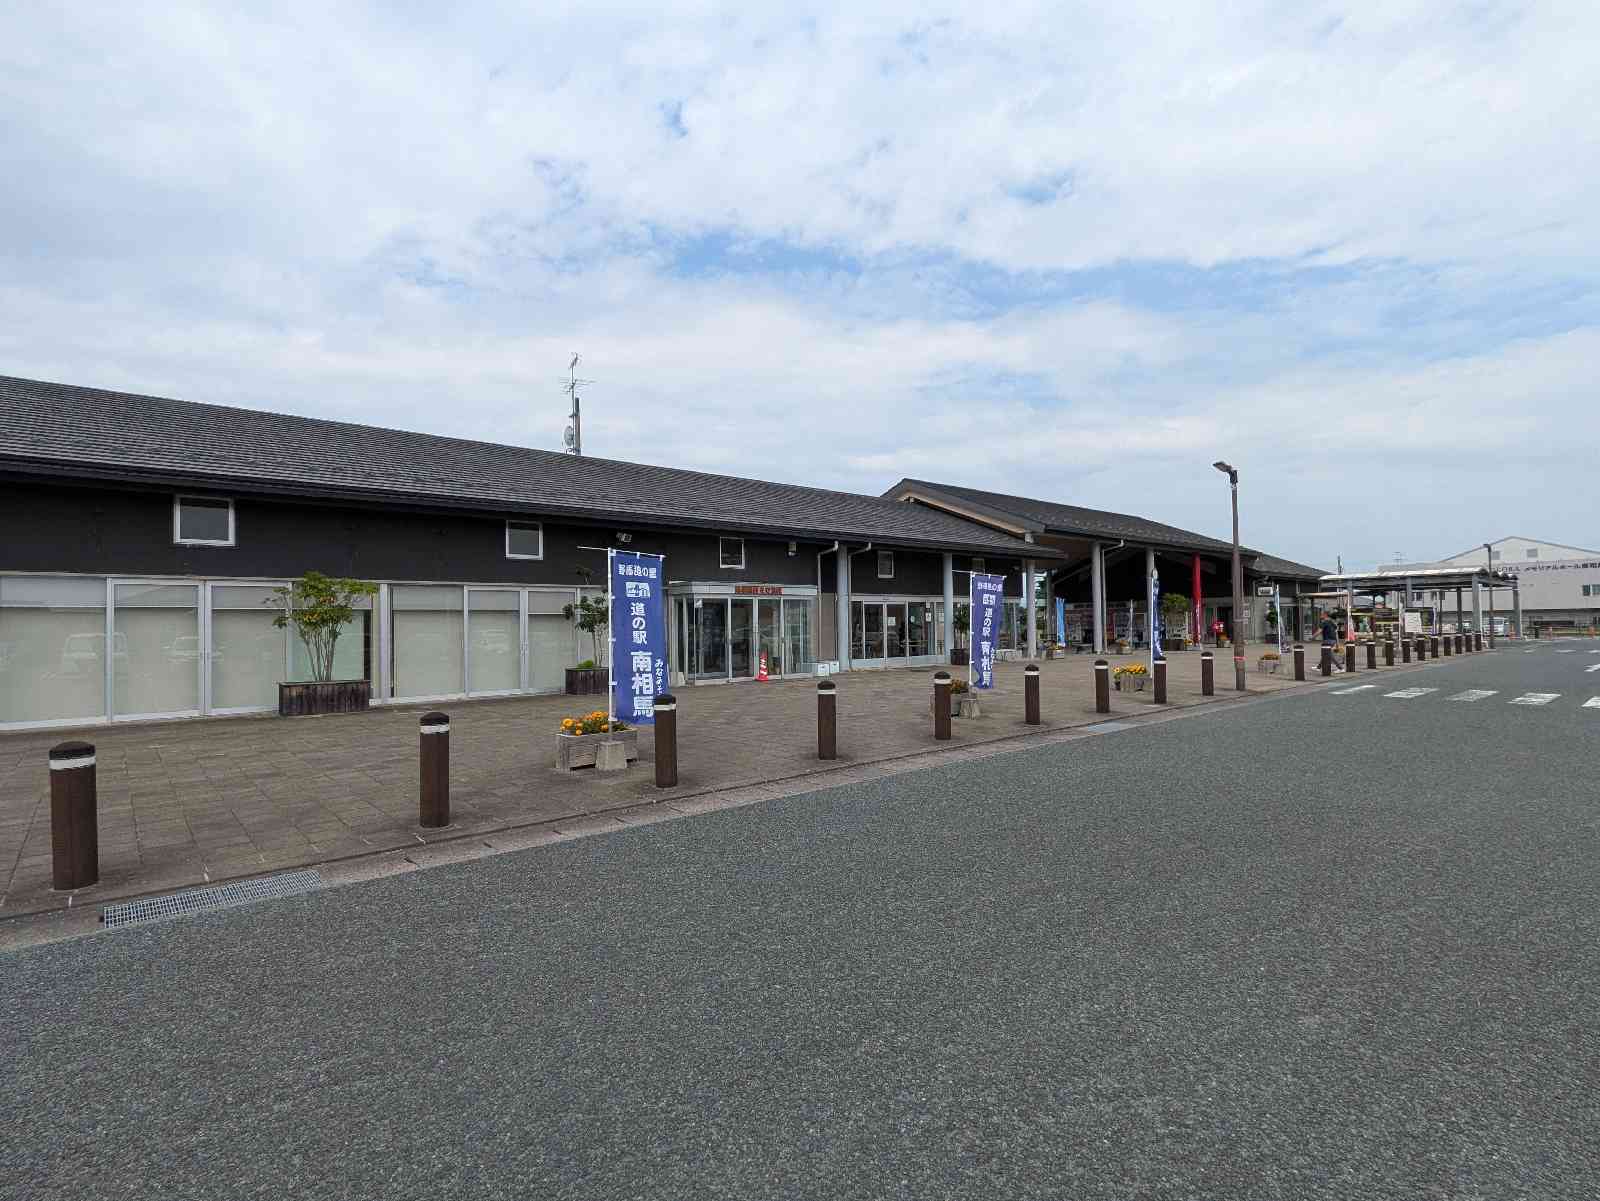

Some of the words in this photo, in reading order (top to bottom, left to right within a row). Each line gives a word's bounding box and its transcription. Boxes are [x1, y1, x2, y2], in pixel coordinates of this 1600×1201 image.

[631, 602, 648, 645] 道の駅
[630, 651, 655, 718] 南相馬
